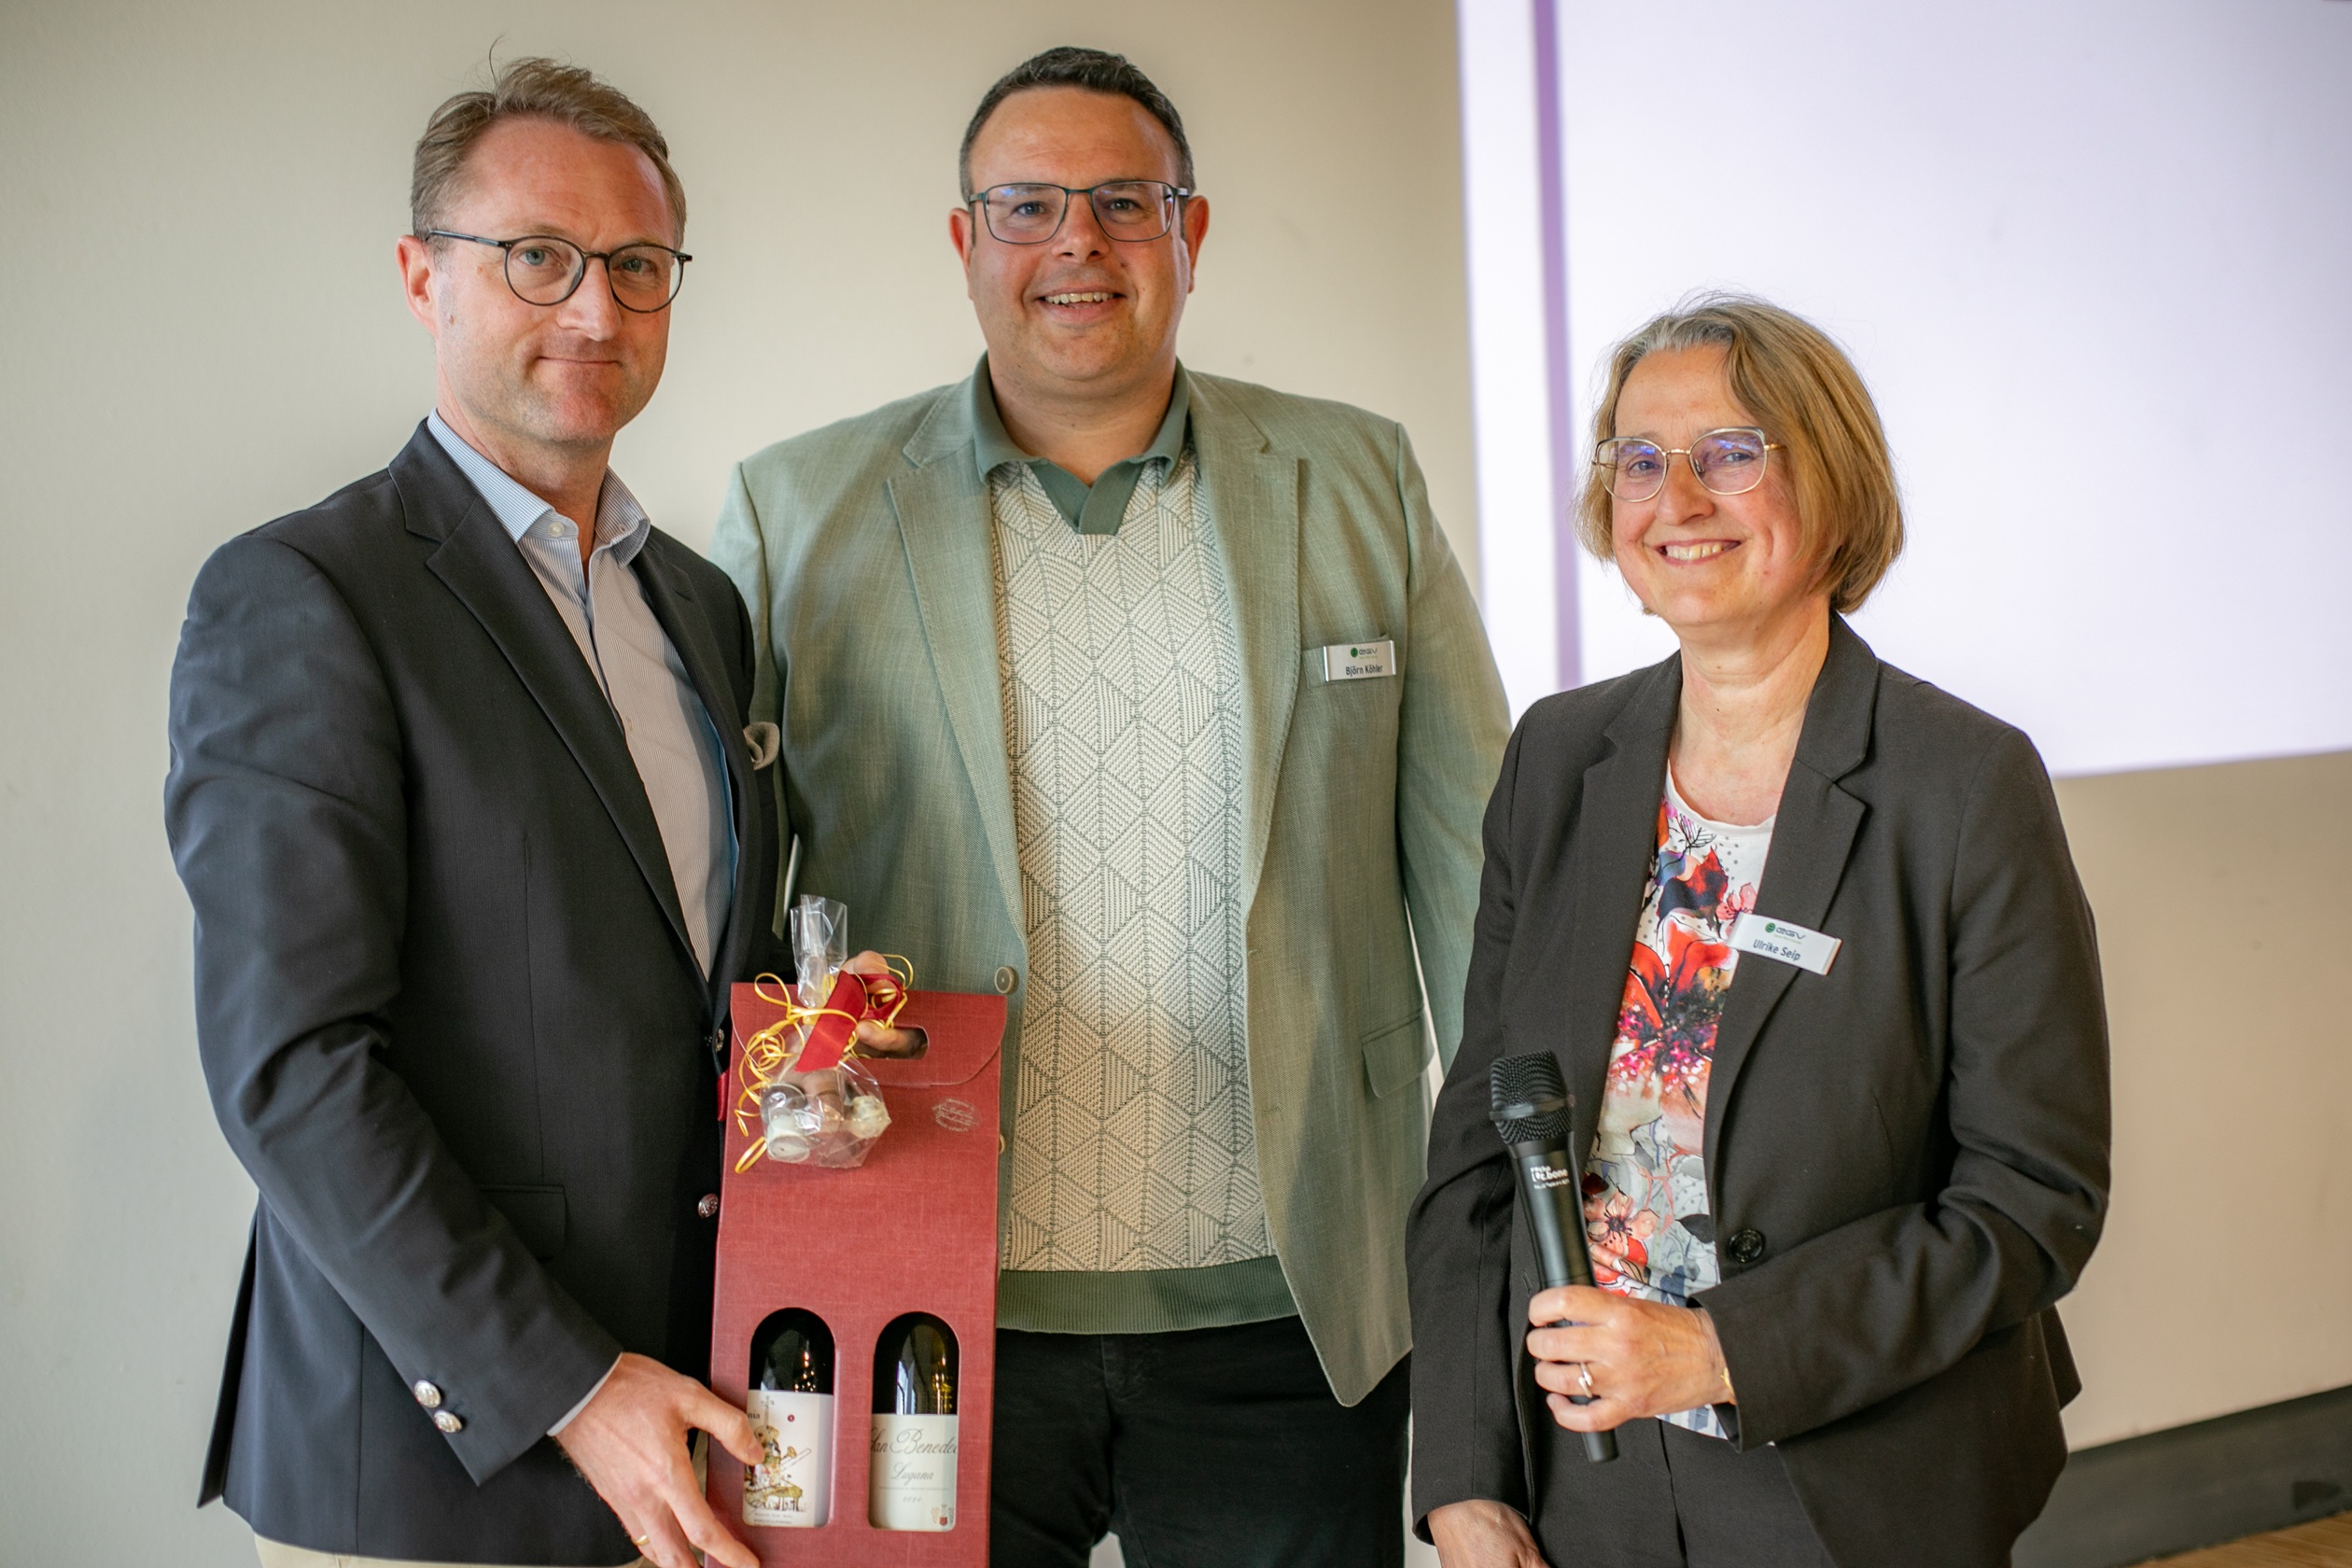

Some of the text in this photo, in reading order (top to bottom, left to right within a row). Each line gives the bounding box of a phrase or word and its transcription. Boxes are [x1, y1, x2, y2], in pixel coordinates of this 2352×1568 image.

[1346, 664, 1383, 677] Björn Köhler
[1753, 939, 1779, 954] Ulrike
[1780, 946, 1801, 961] Seip
[890, 1462, 934, 1486] Lugana
